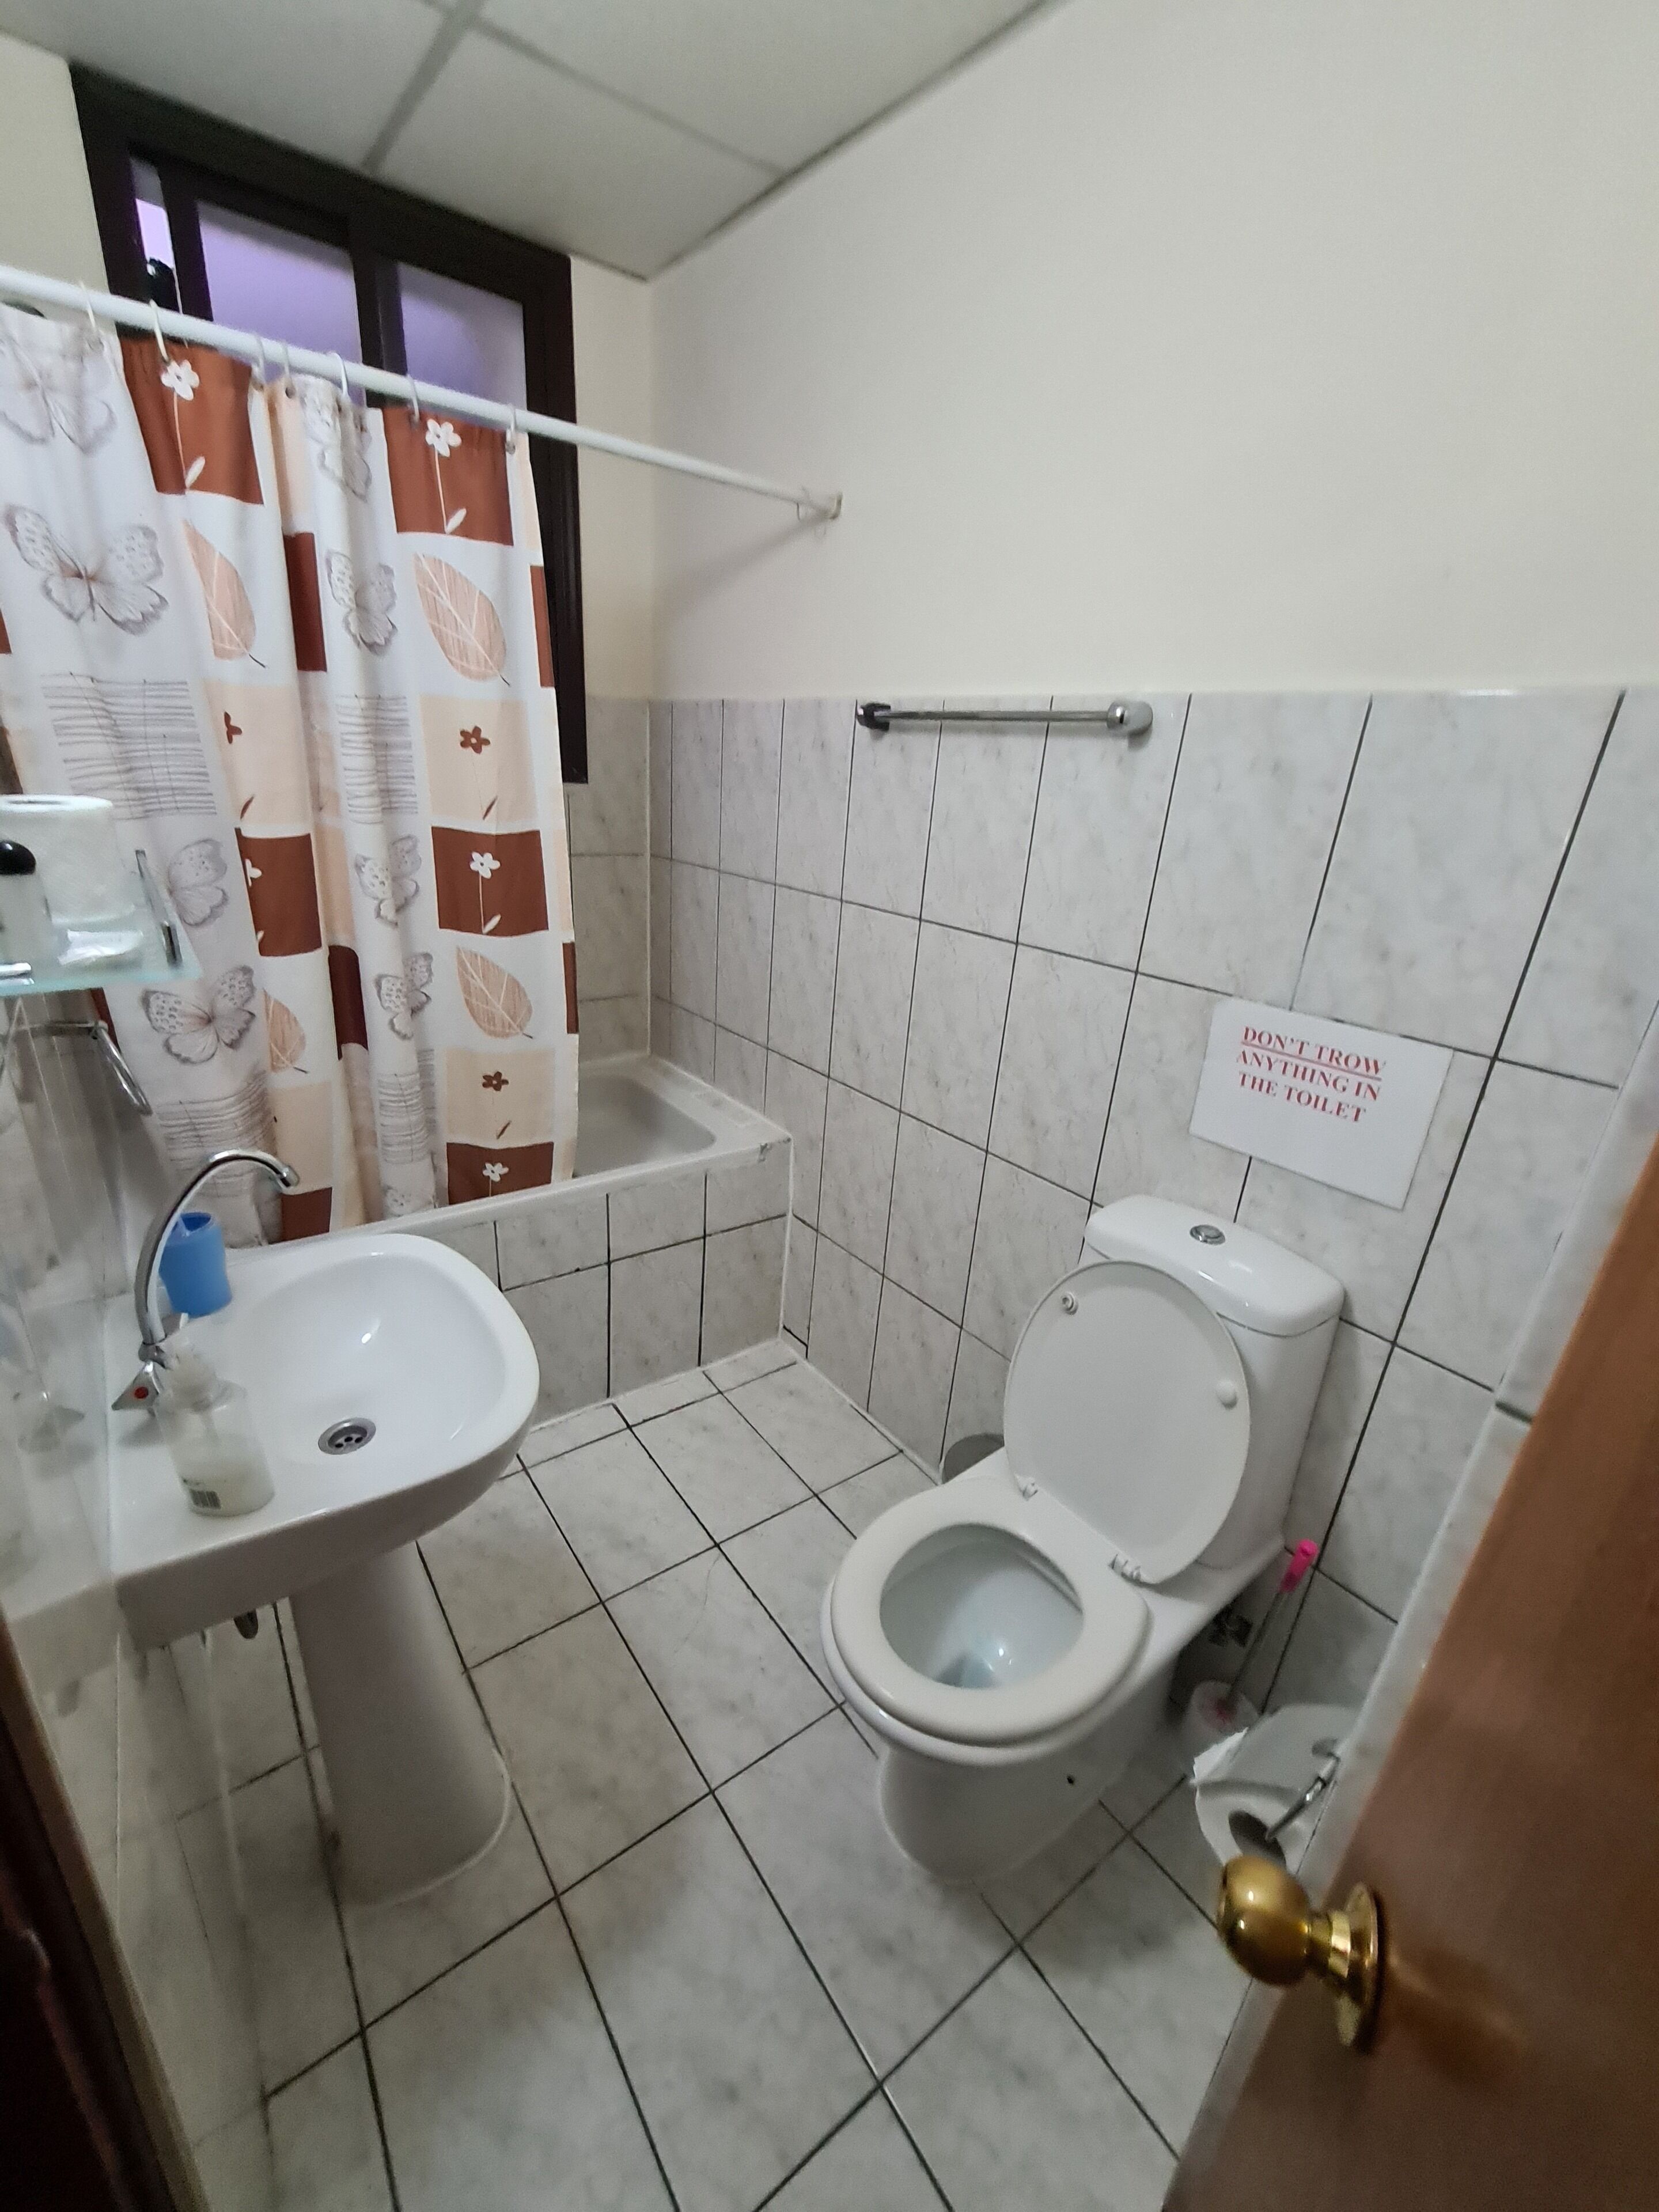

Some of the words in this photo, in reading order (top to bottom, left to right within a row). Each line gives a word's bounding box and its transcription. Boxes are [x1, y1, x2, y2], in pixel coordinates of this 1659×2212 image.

[1237, 1050, 1349, 1093] ANYTHING
[1355, 1081, 1380, 1101] IN
[1243, 1026, 1309, 1055] DON'T
[1315, 1043, 1386, 1075] TROW
[1239, 1071, 1278, 1097] THE
[1285, 1085, 1366, 1122] TOILET
